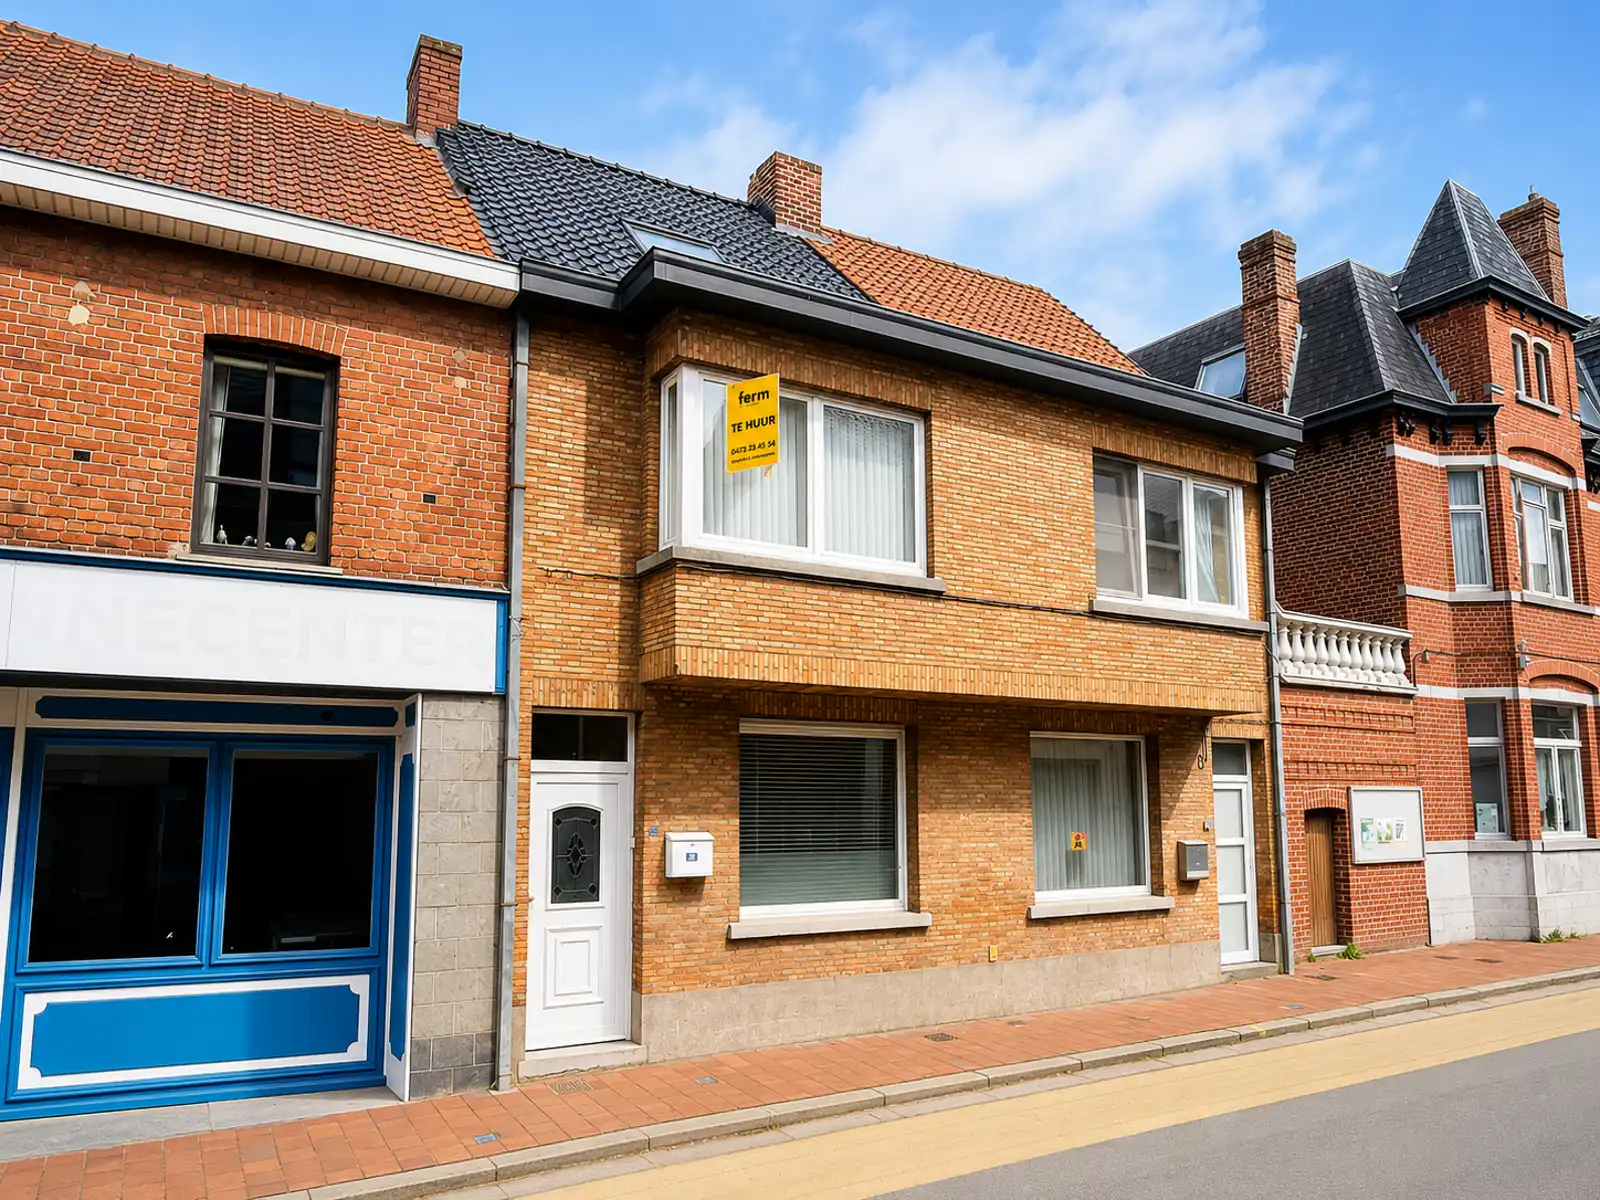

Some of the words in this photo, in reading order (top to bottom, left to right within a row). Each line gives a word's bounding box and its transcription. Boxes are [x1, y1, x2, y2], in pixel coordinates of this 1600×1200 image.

[738, 389, 769, 405] ferm
[731, 422, 743, 433] TE
[745, 415, 776, 430] HUUR
